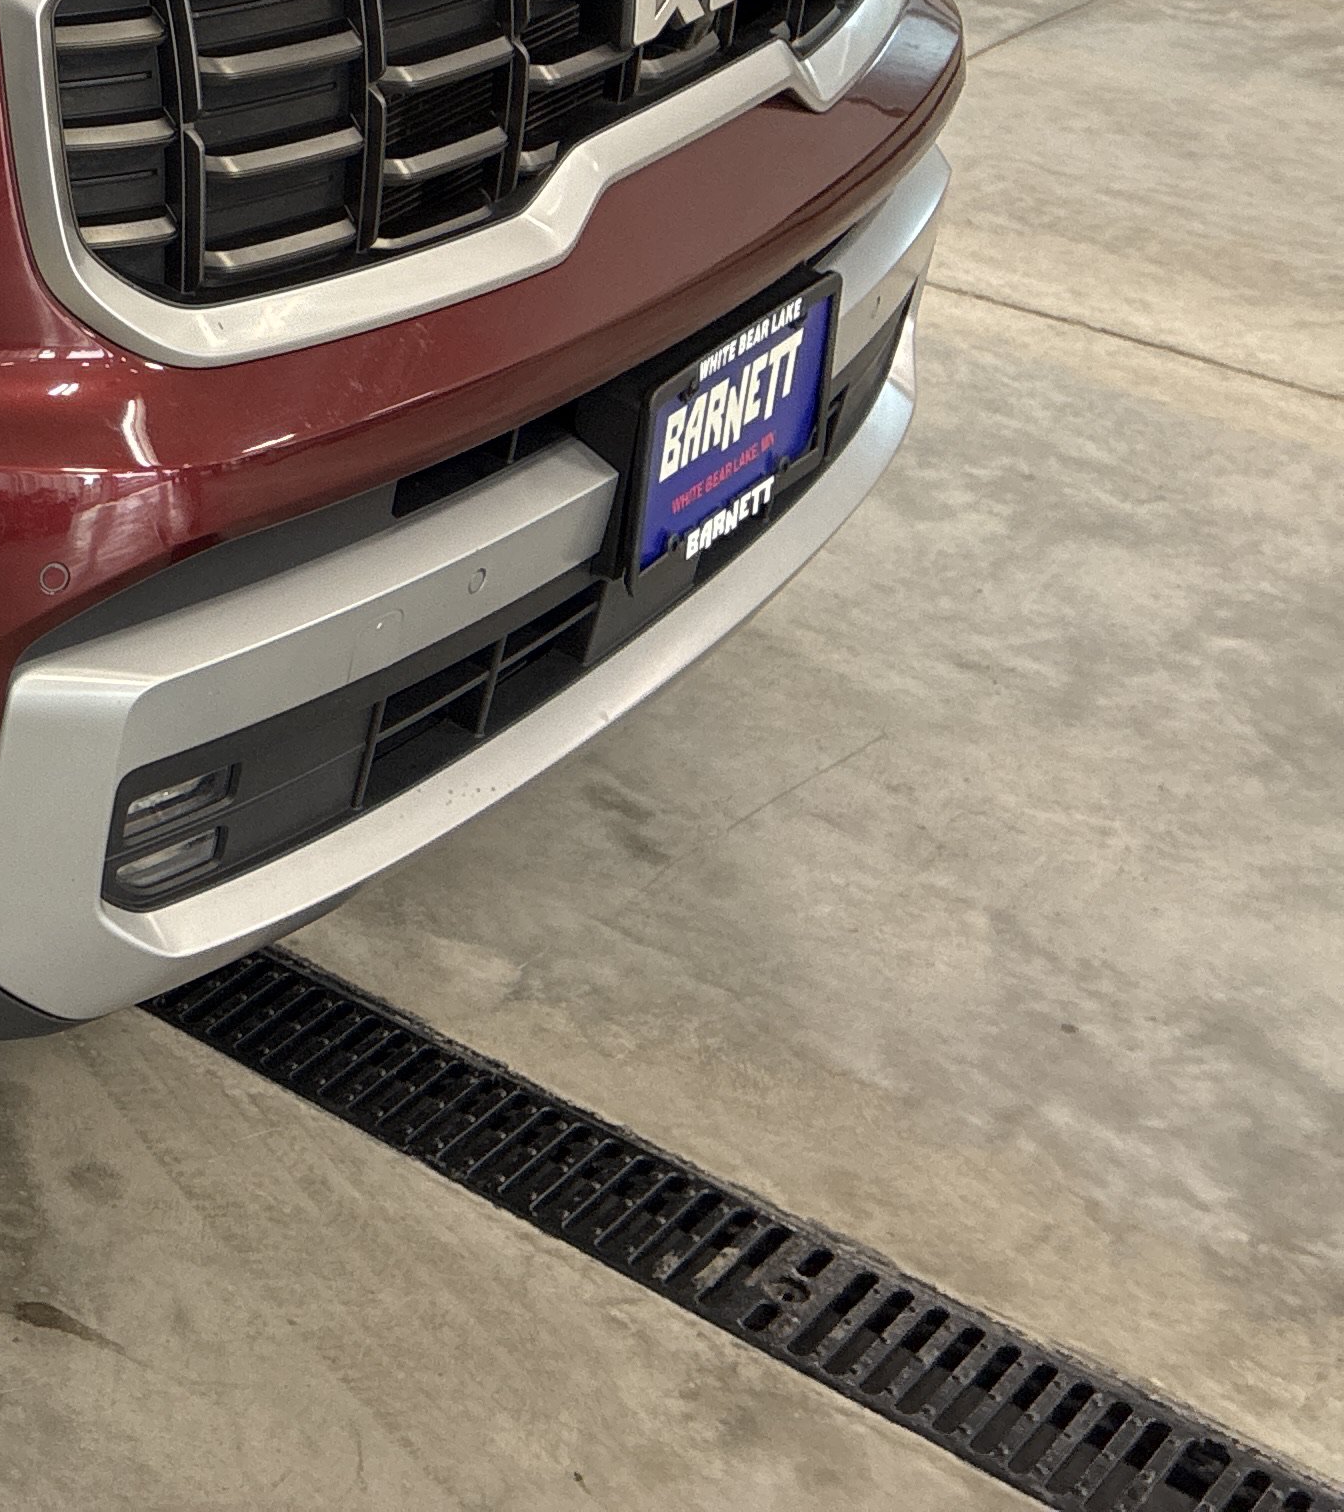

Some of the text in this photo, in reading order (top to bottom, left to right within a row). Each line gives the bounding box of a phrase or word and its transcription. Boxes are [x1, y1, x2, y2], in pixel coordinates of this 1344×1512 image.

[699, 297, 803, 383] WHITE BEAR LAKE
[659, 327, 804, 483] BARNETT
[685, 475, 775, 561] BARNETT
